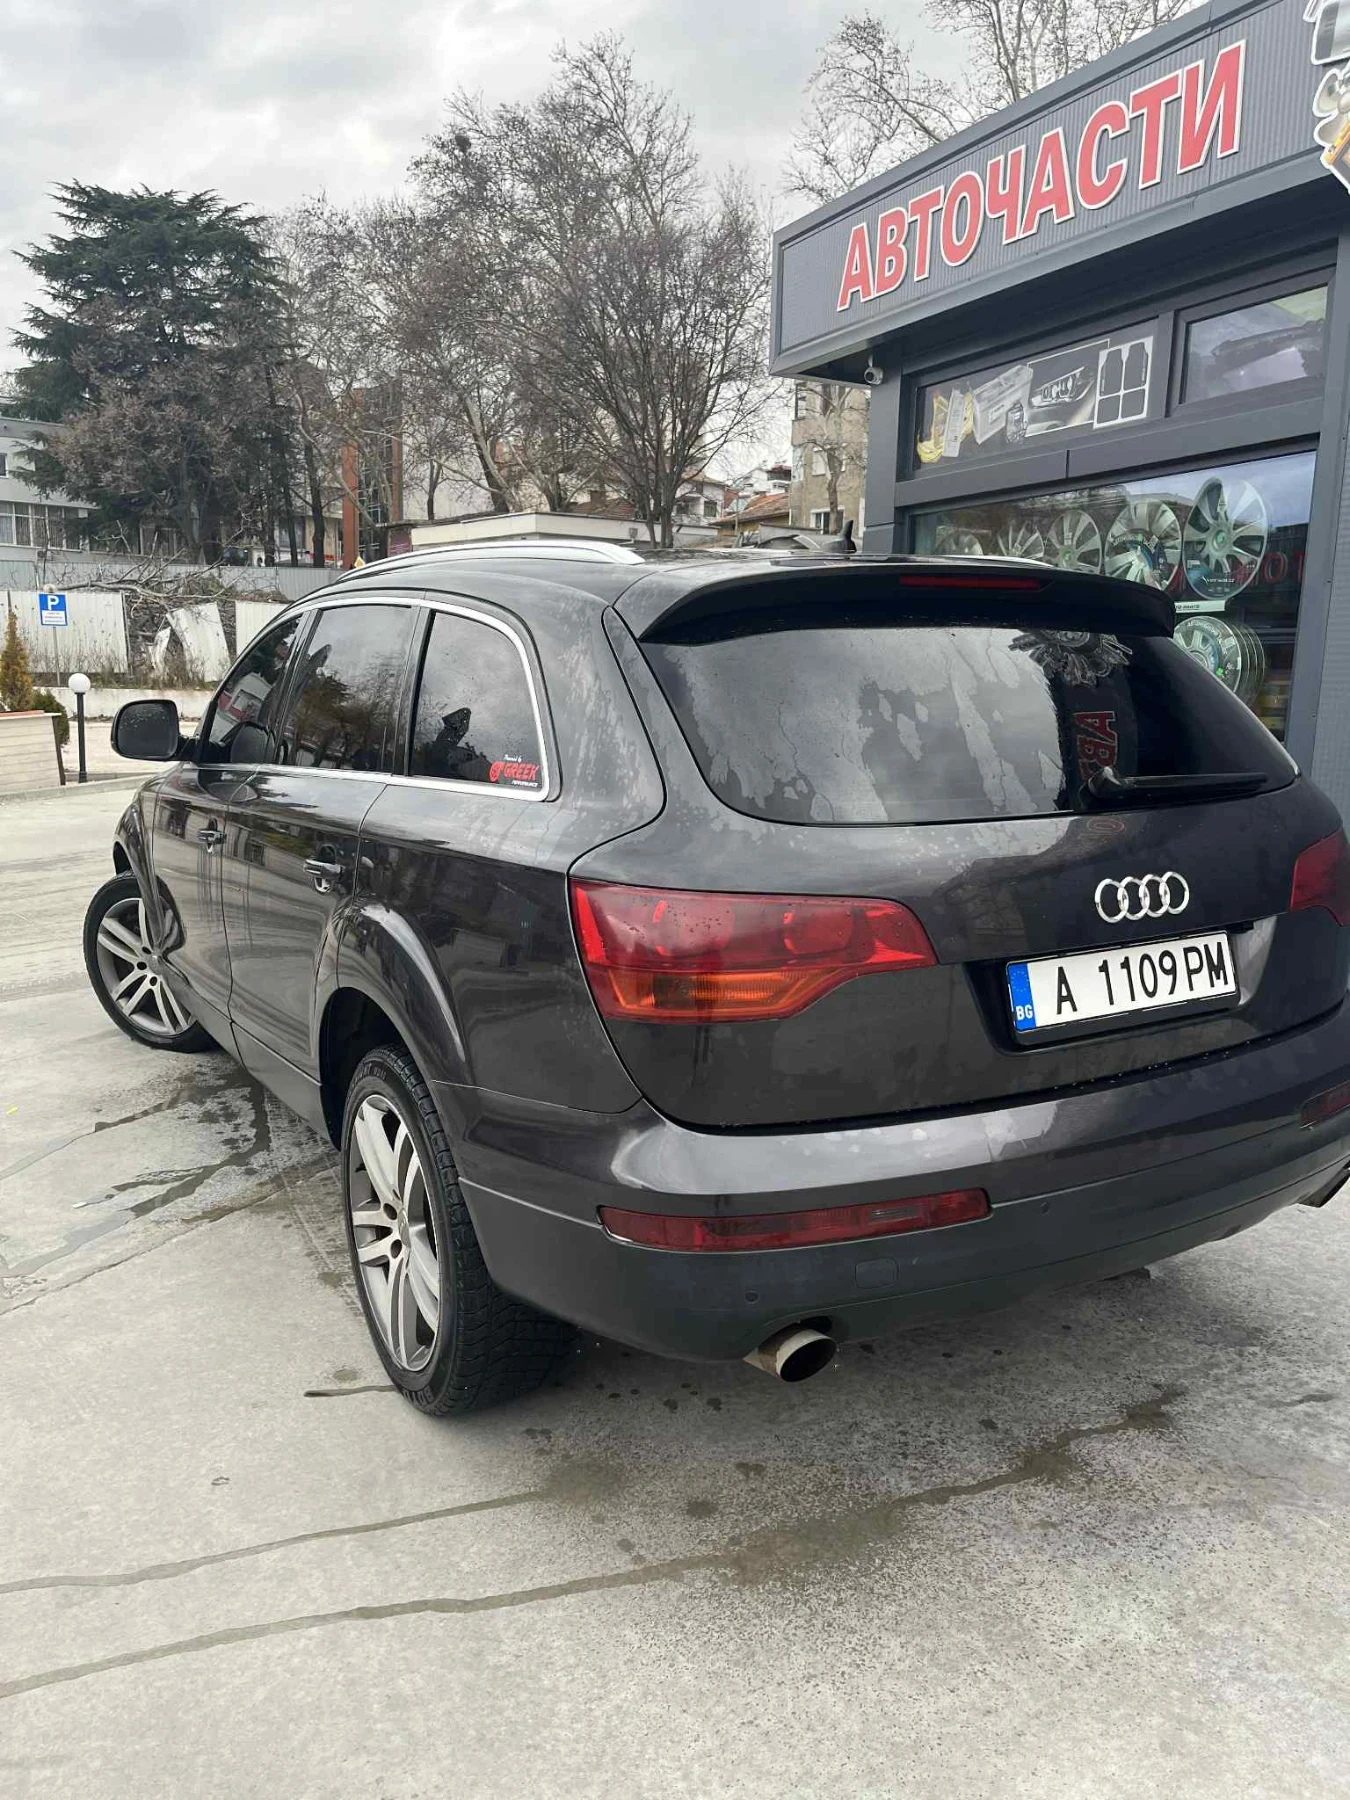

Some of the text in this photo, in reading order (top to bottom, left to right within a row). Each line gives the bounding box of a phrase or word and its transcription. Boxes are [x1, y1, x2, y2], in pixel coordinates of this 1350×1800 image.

[837, 39, 1248, 313] АВТОЧАСТИ
[47, 595, 60, 611] P
[1015, 1004, 1034, 1020] BG
